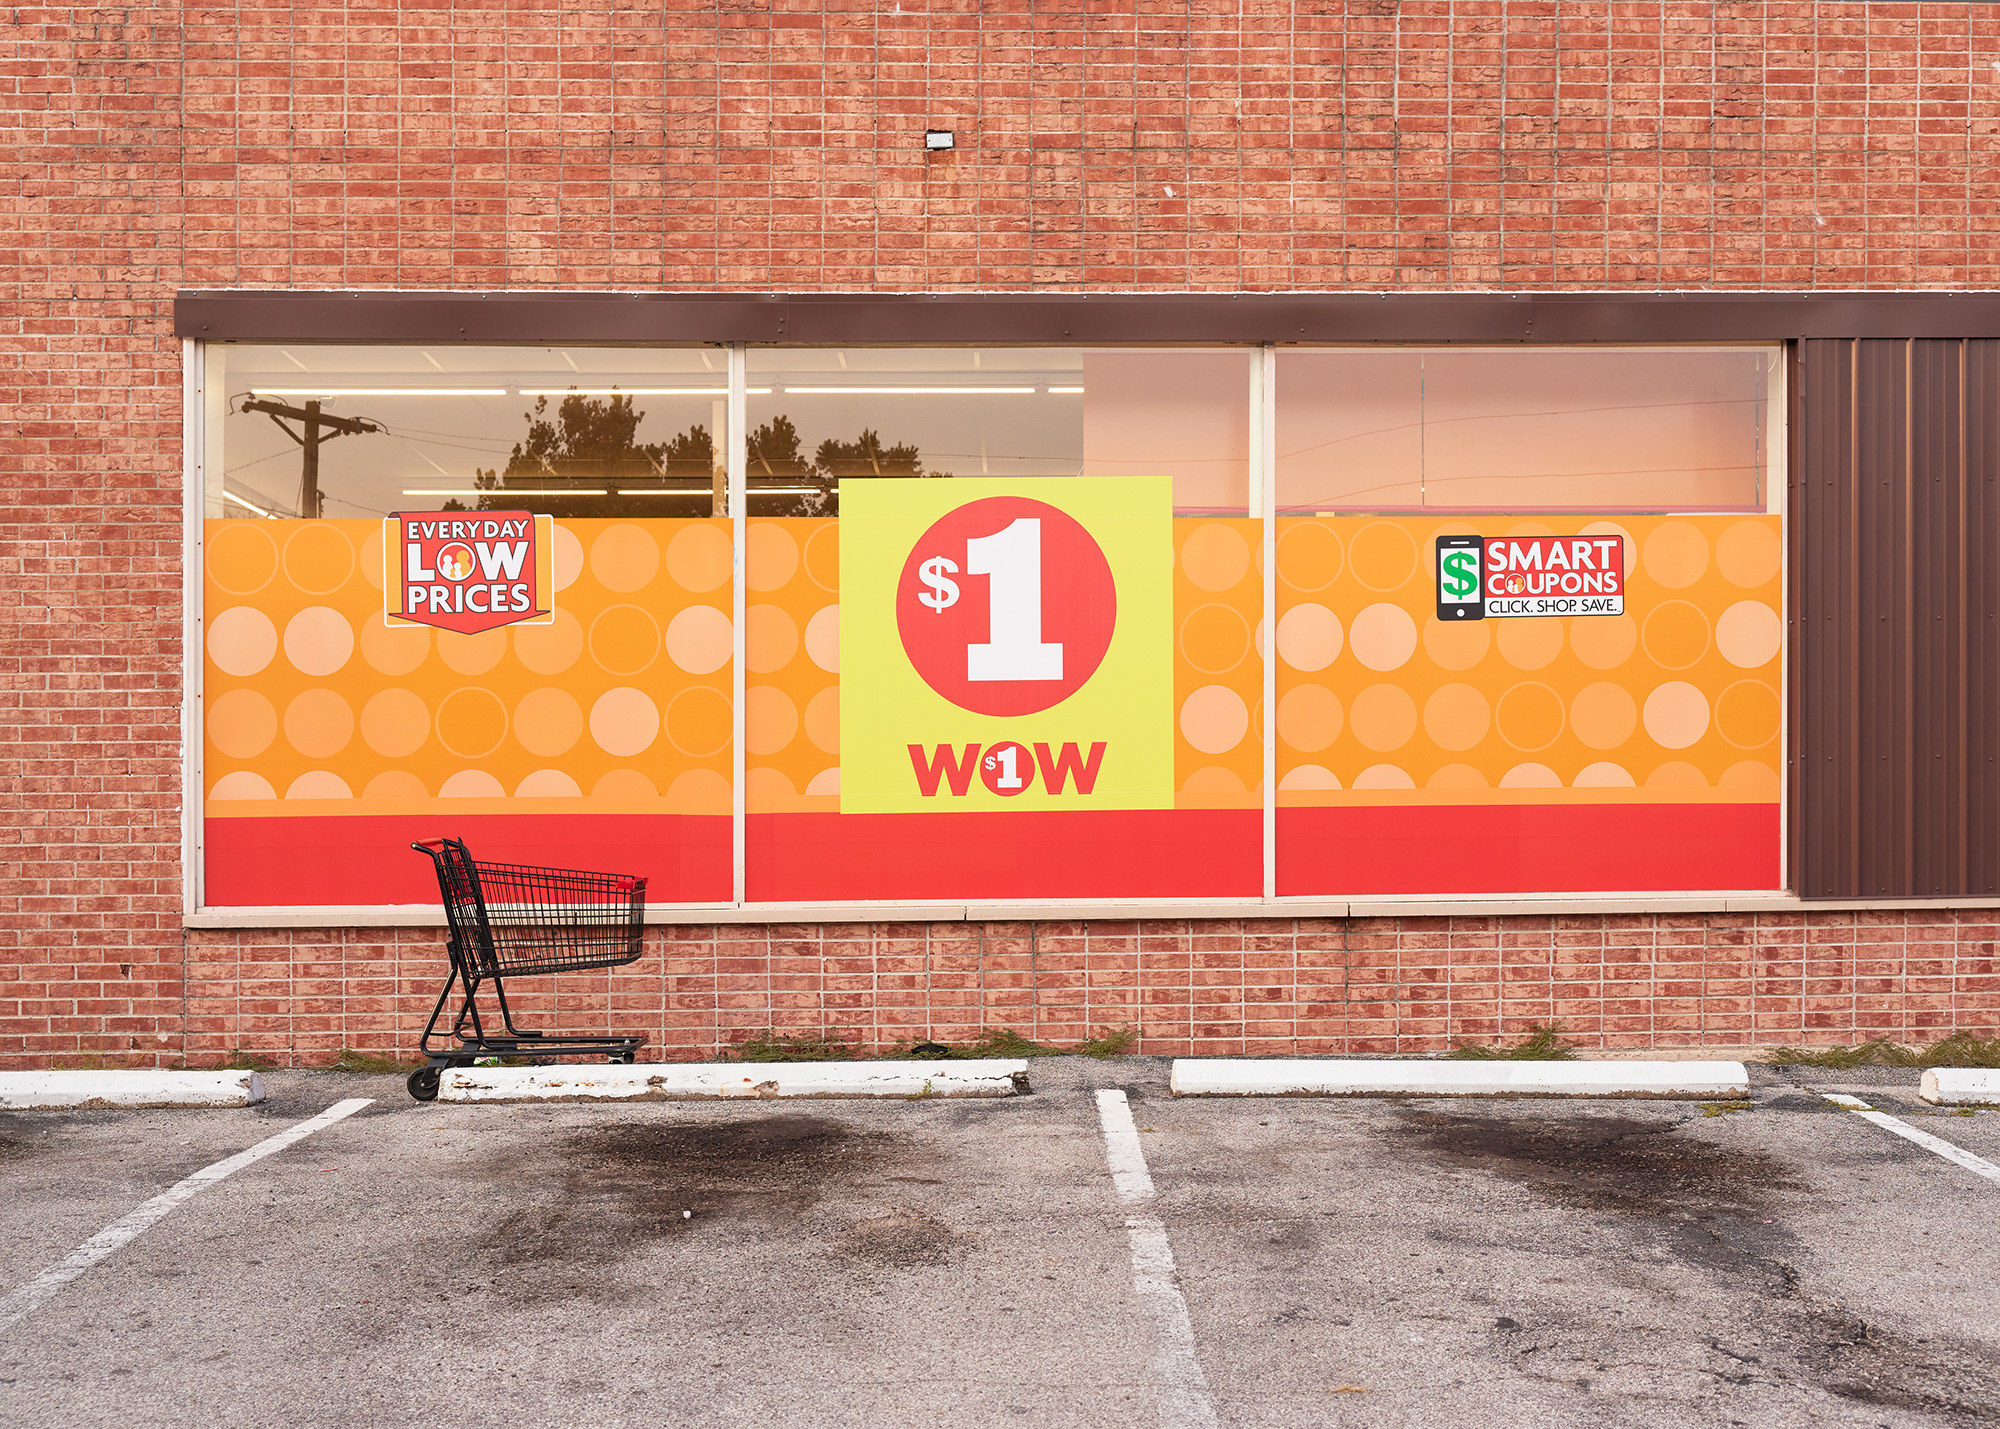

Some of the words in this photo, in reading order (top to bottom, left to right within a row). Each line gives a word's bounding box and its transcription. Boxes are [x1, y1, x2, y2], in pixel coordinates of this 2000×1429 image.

[407, 519, 530, 540] EVERYDAY
[1487, 540, 1618, 572] SMART
[1487, 571, 1618, 595] COUPONS
[407, 583, 531, 614] PRICES
[917, 517, 1064, 681] $1
[1488, 600, 1534, 614] CLICK.
[1537, 599, 1577, 613] SHOP.
[1581, 598, 1617, 612] SAVE.
